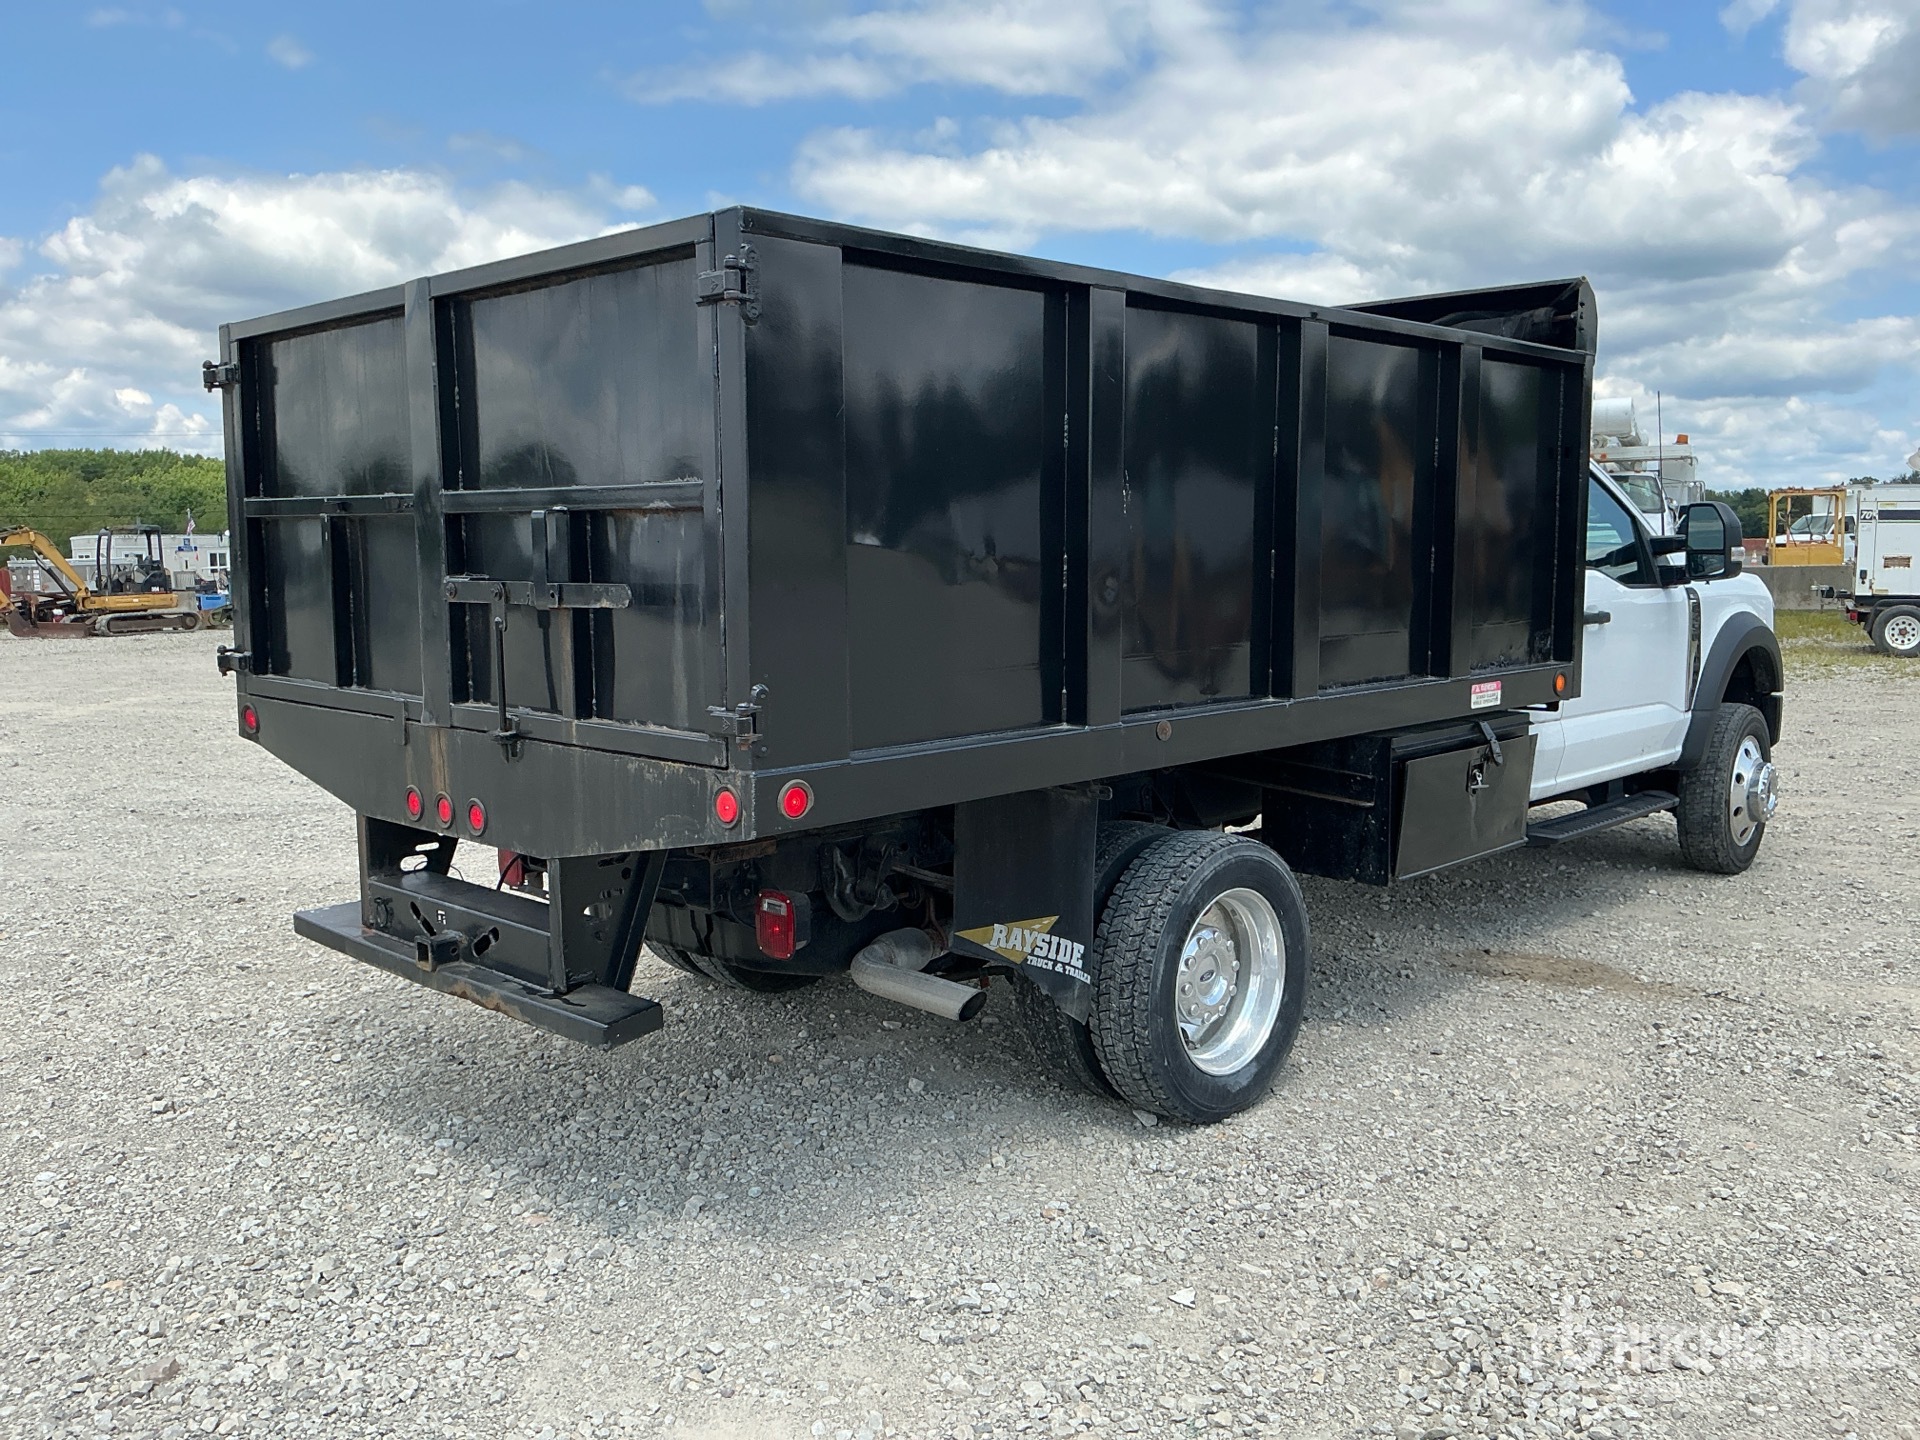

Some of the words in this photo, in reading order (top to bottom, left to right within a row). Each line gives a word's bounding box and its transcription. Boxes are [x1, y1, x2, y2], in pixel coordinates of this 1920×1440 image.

[990, 923, 1085, 969] RAYSIDE
[1027, 955, 1053, 970] TRUCK
[1055, 963, 1063, 973] &
